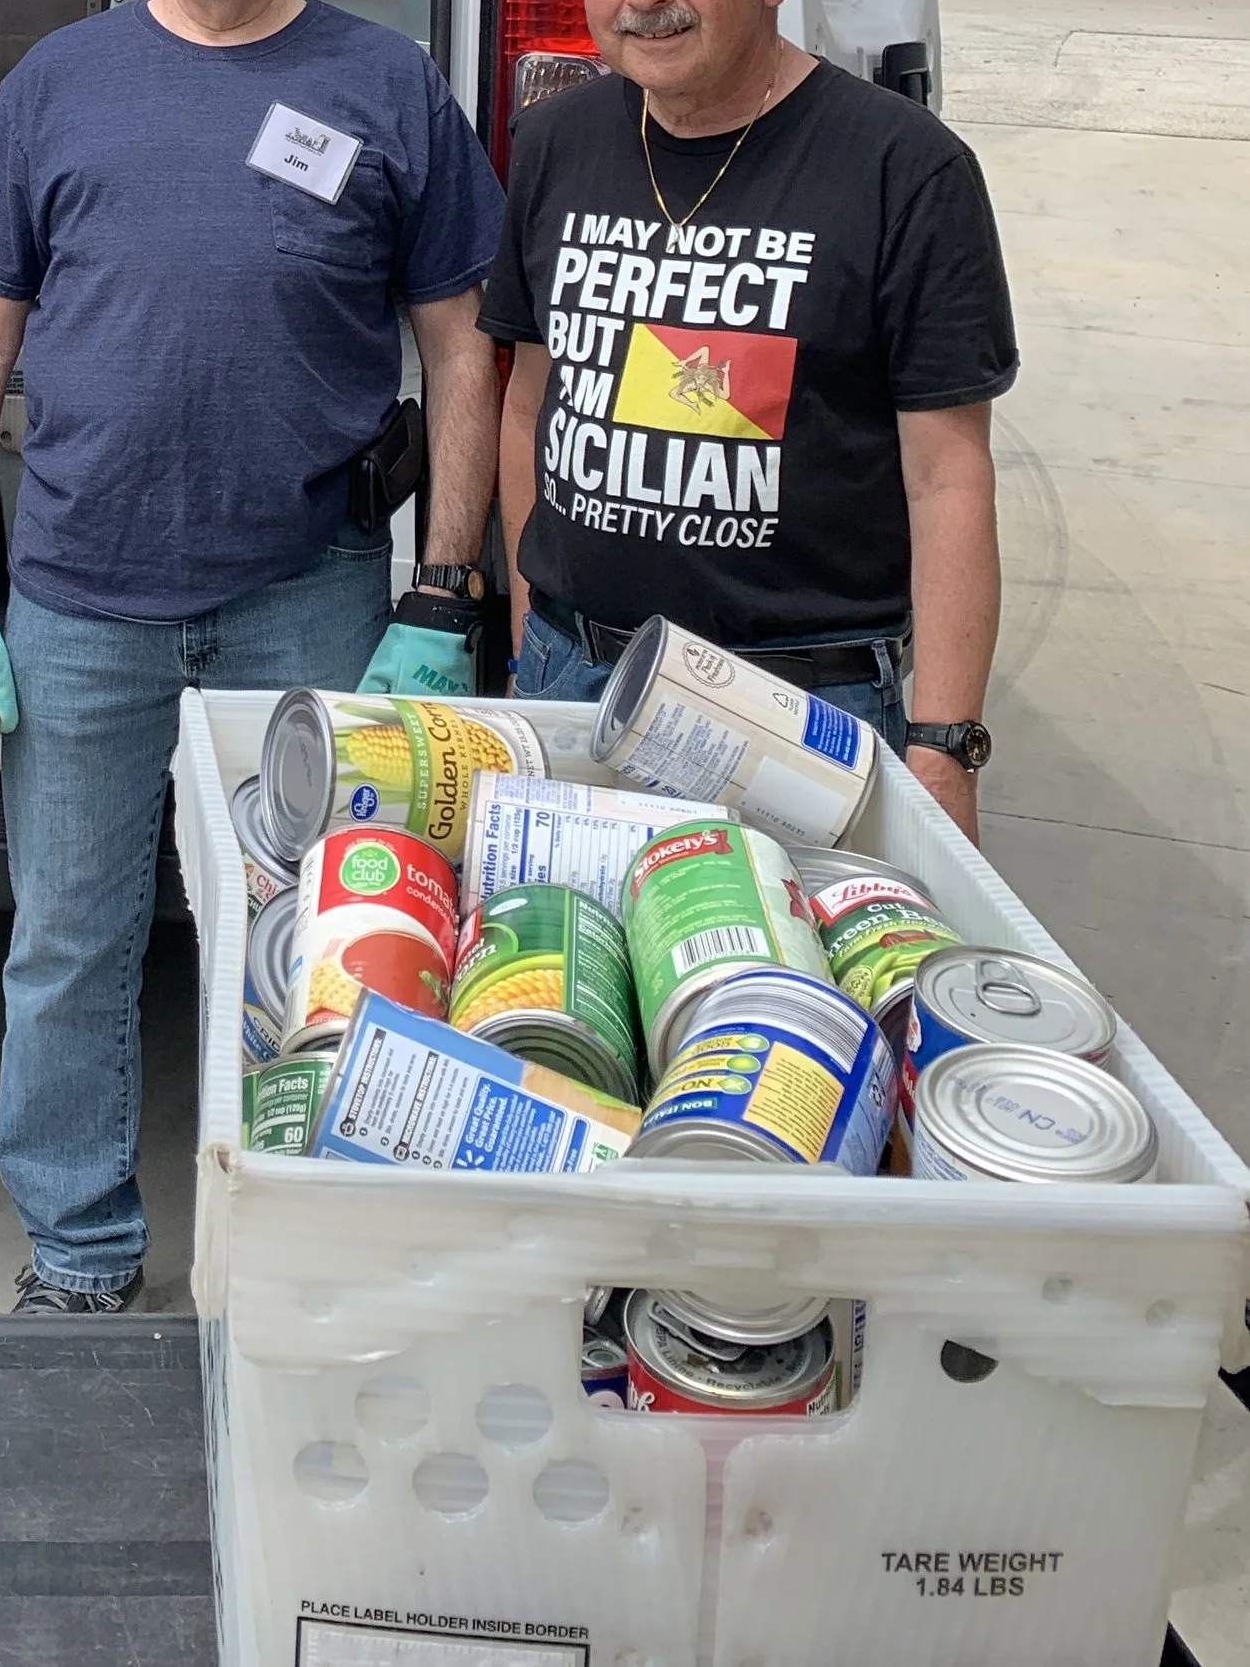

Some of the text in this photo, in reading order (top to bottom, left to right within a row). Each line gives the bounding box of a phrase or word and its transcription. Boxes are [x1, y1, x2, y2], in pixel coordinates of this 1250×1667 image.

[284, 154, 309, 172] Jim
[562, 212, 816, 264] I MAY NOT BE
[550, 247, 809, 330] PERFECT
[549, 310, 625, 366] BUT
[545, 406, 782, 512] SICILIAN
[544, 472, 779, 548] SO... PRETTY CLOSE
[408, 711, 429, 811] SUPERSWEET
[522, 745, 534, 776] NET WT
[428, 747, 457, 842] Golden
[458, 766, 471, 812] WHOLE
[485, 803, 502, 838] Facts
[512, 828, 521, 841] cup
[535, 811, 551, 828] 70
[352, 855, 388, 870] food
[526, 853, 535, 875] serving
[634, 830, 719, 878] Stokely's
[352, 868, 385, 881] club
[509, 864, 517, 880] size
[867, 902, 905, 912] Cut
[279, 1078, 308, 1092] Facts
[347, 1037, 383, 1120] STOVETOP INSTRUCTIONS:
[286, 1104, 306, 1113] (125g)
[463, 1081, 493, 1144] Great Quality.
[680, 1095, 713, 1114] BON
[283, 1124, 304, 1145] 60
[400, 1100, 422, 1143] MICROWAVE
[473, 1094, 498, 1149] Great Price.
[483, 1095, 509, 1153] Guaranteed.
[706, 1374, 783, 1390] Recyclable
[881, 1552, 1064, 1572] TARE WEIGHT
[916, 1577, 1025, 1597] 1.84 LBS
[301, 1600, 589, 1640] PLACE LABEL HOLDER INSIDE BORDER
